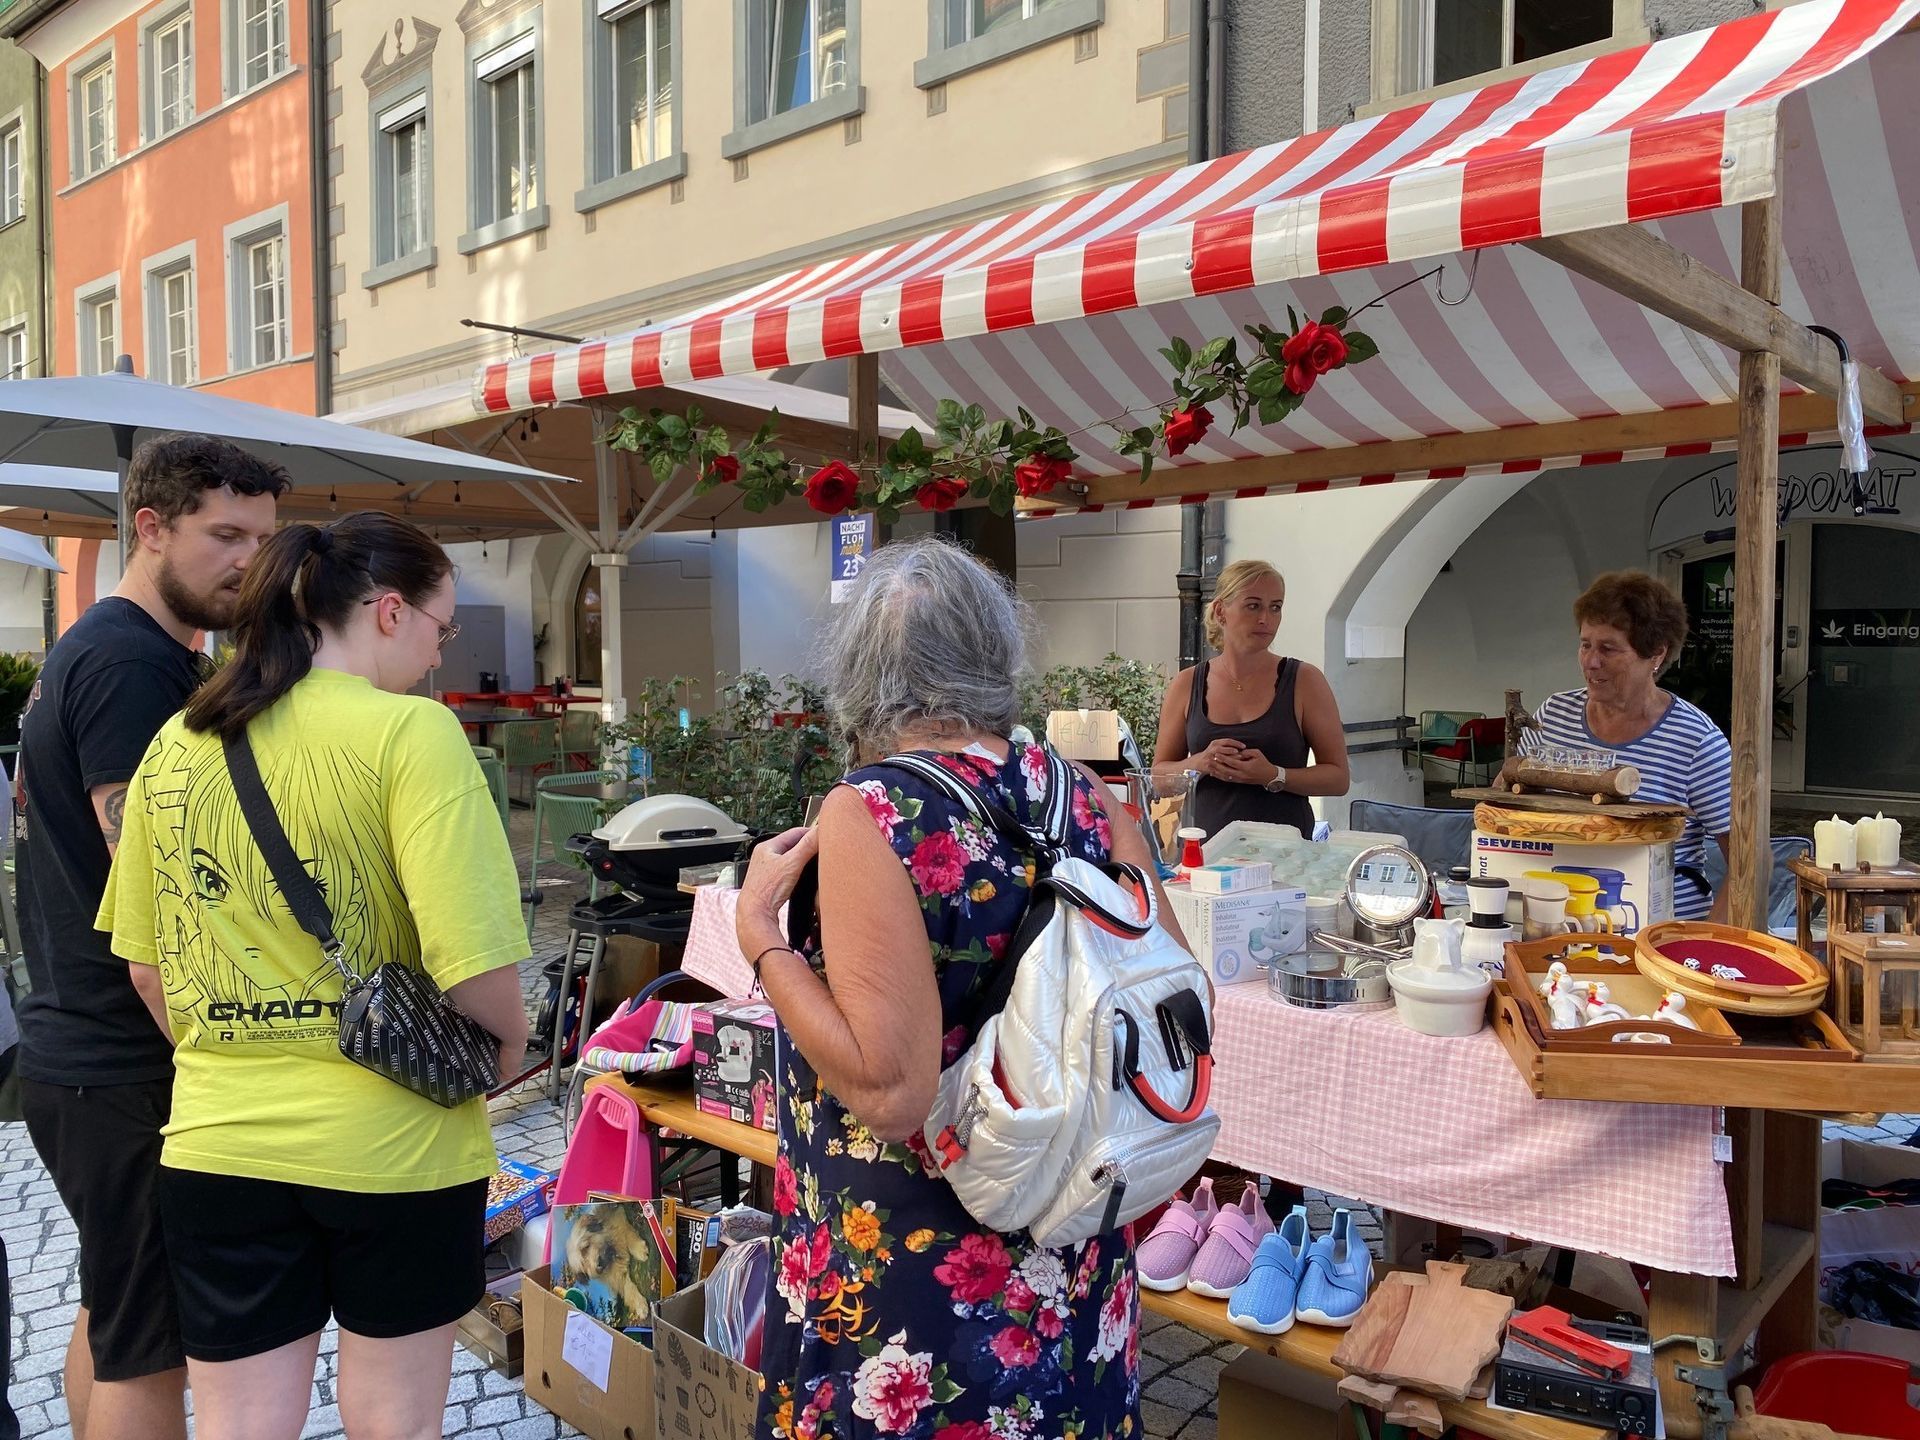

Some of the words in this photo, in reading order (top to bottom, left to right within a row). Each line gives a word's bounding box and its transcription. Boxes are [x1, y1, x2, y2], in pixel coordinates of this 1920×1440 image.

[1710, 467, 1916, 517] WDOMAT
[841, 522, 864, 533] NACHT
[841, 533, 864, 545] FLOH
[1853, 623, 1919, 639] Eingang
[1477, 837, 1554, 852] SEVERIN
[506, 1186, 535, 1202] 1000
[692, 1221, 704, 1253] 300
